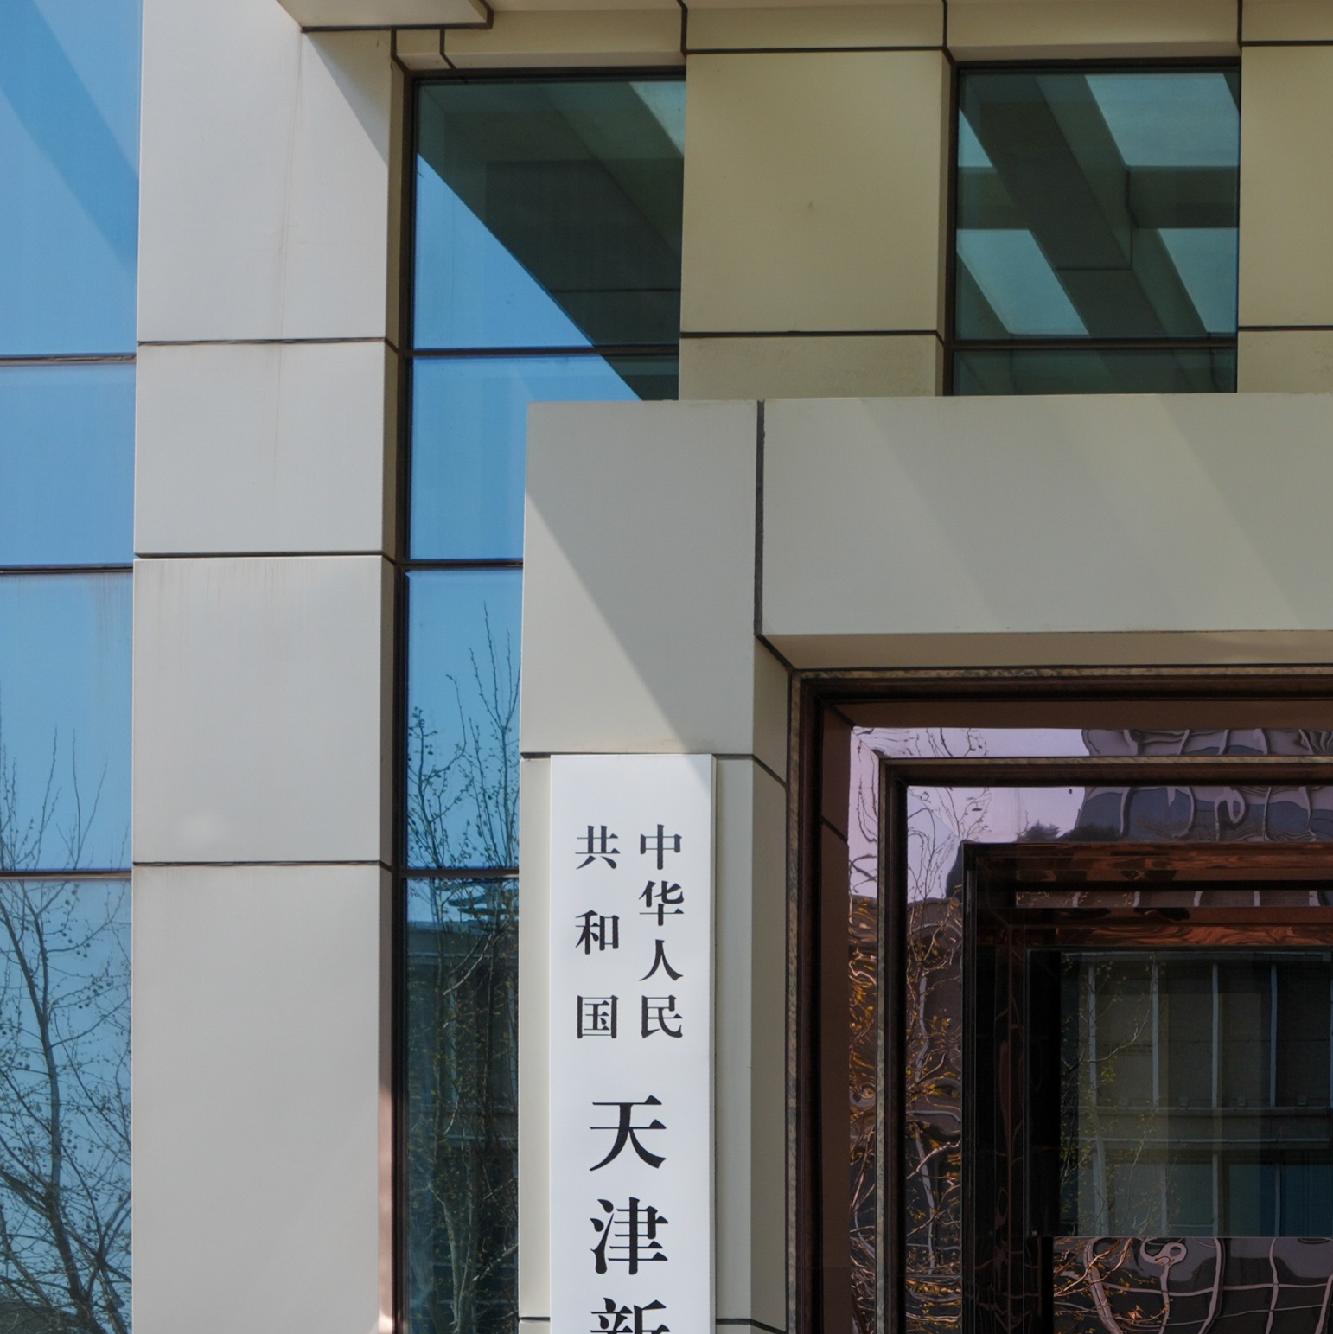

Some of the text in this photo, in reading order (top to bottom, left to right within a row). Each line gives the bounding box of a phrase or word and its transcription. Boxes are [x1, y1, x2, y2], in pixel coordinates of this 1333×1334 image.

[575, 825, 621, 1040] 共和国
[638, 825, 684, 1040] 中华人民
